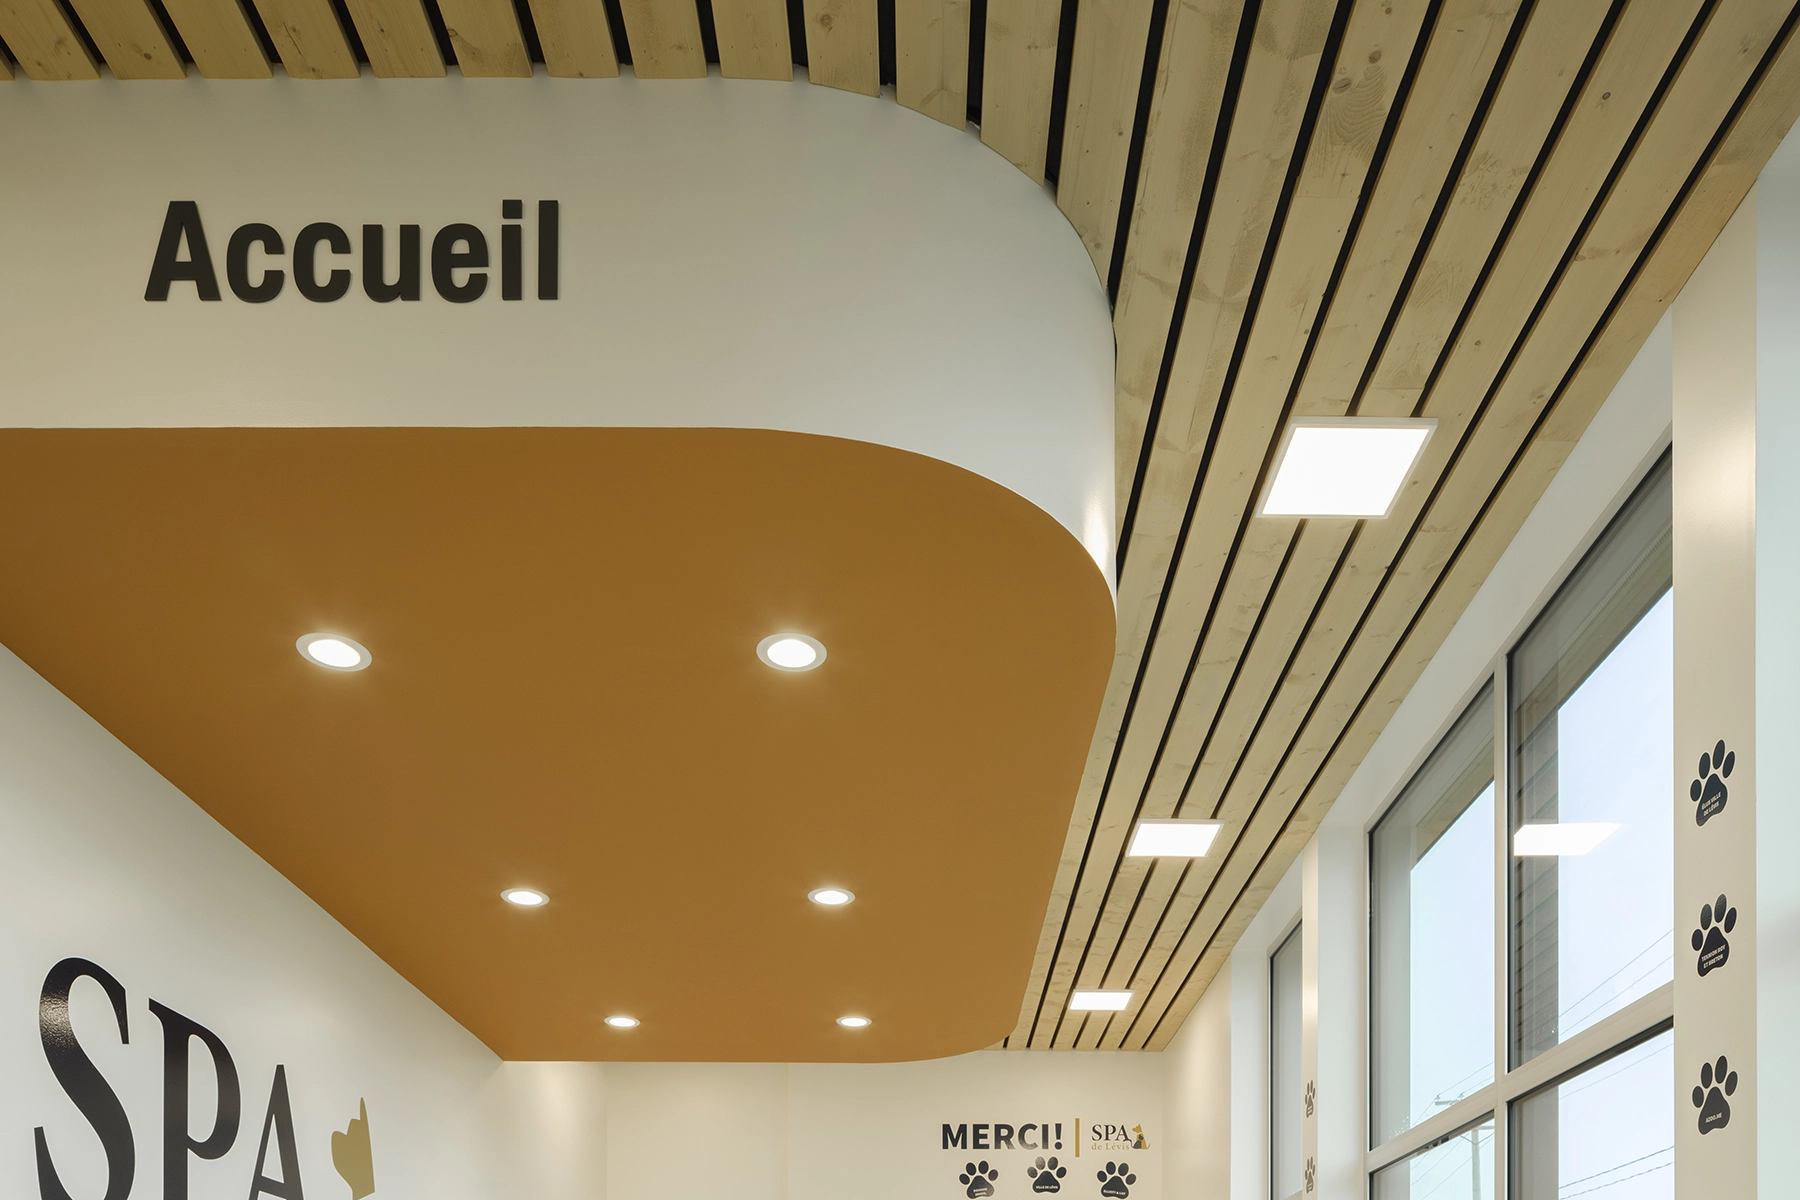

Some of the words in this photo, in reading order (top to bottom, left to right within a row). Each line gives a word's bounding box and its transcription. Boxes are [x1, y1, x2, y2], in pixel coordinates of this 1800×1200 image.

[143, 199, 561, 304] Accueil
[942, 1123, 1063, 1150] MERCI!
[1091, 1123, 1130, 1142] SPA
[1091, 1142, 1103, 1150] de
[1105, 1142, 1130, 1151] Lévis
